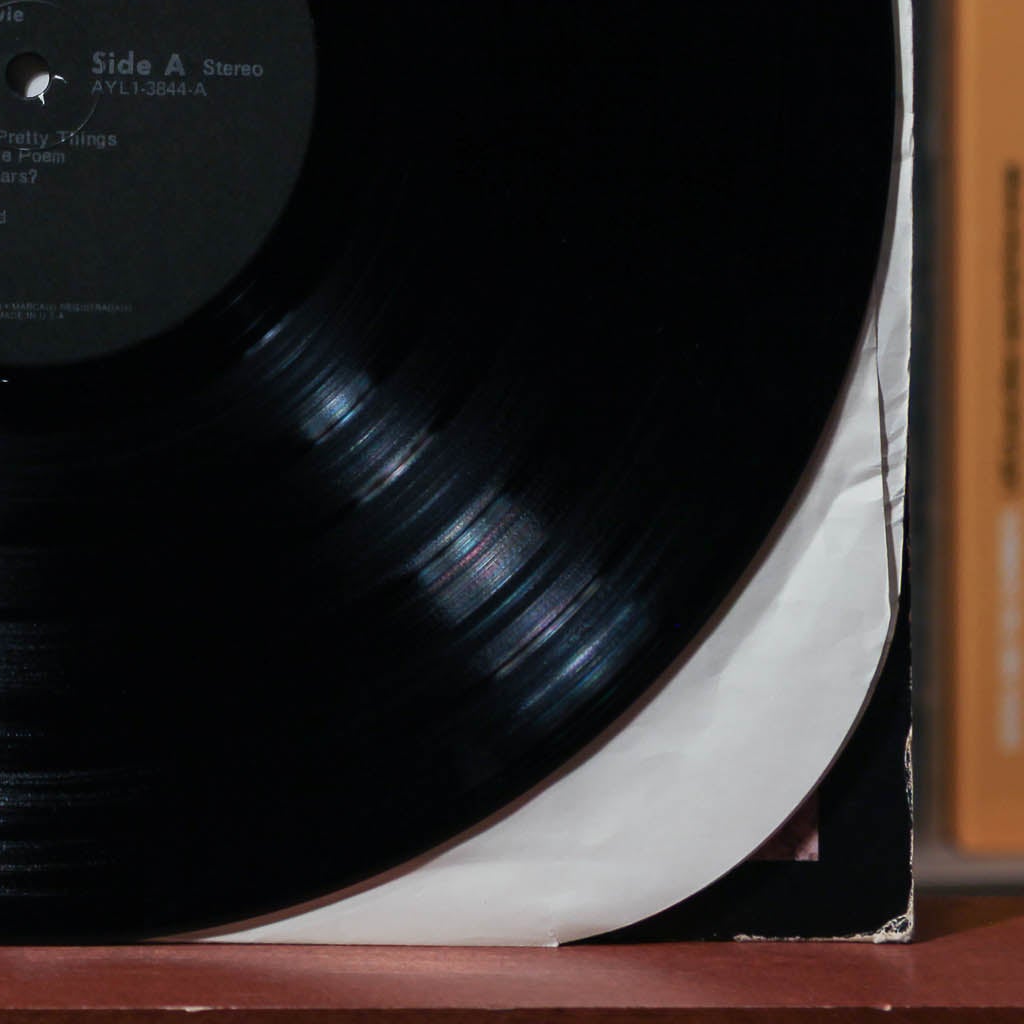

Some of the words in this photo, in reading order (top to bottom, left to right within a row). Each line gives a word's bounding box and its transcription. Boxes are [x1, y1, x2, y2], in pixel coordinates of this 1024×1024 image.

[91, 50, 152, 75] Side
[164, 53, 186, 76] A
[203, 59, 263, 77] Stereo
[90, 80, 208, 96] AYL1-3844-A
[56, 130, 118, 149] Things
[18, 148, 65, 163] Poem
